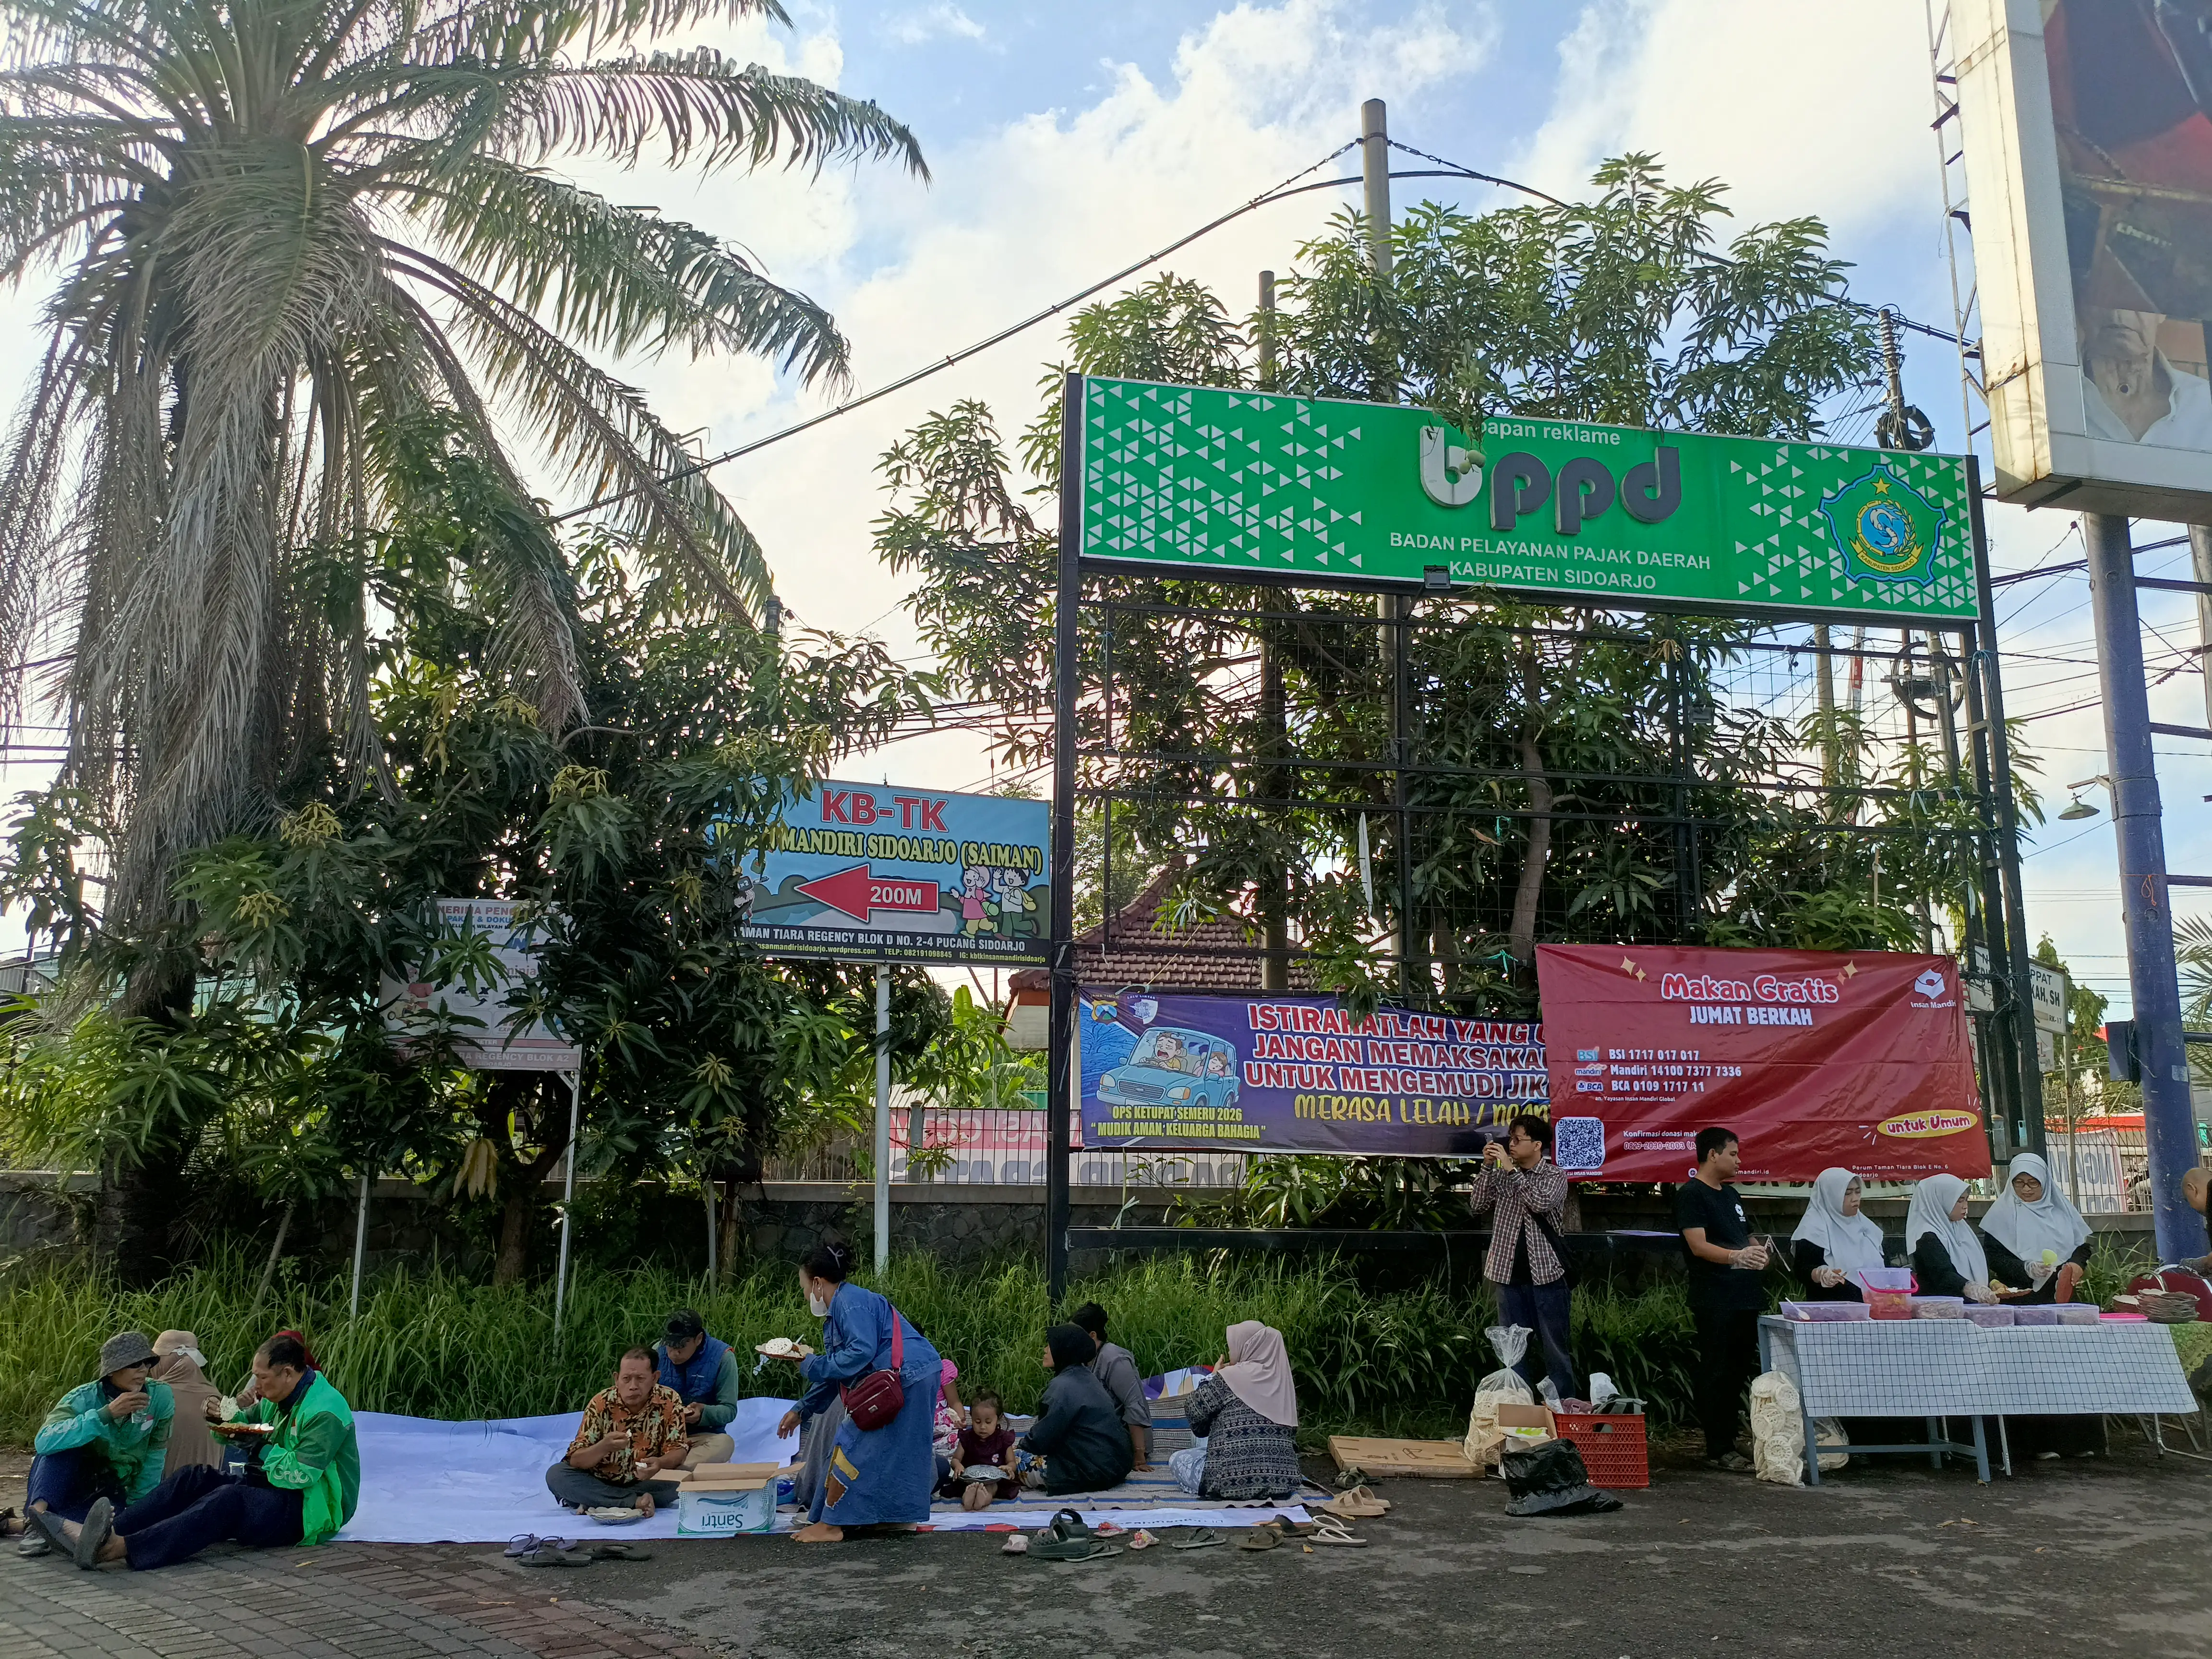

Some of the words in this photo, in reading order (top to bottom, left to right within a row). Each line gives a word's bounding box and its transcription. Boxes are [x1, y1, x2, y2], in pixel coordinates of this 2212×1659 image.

[1543, 425, 1621, 445] reklame
[1420, 425, 1681, 534] bppd
[1391, 532, 1455, 551] BADAN
[1461, 538, 1568, 559] PELAYANAN
[1574, 546, 1632, 564] PAJAK
[1637, 551, 1710, 570] DAERAH
[1860, 554, 1890, 571] KABUPATEN
[1891, 558, 1915, 571] SIDOARJO
[1449, 561, 1559, 582] KABUPATEN
[1564, 569, 1656, 589] SIDOARJO
[821, 789, 949, 833] KB-TK
[780, 827, 864, 856] MANDIRI
[867, 834, 958, 864] SIDOARJO
[961, 841, 1043, 876] (SAIMAN)
[869, 885, 923, 906] 200M
[773, 928, 805, 941] TIARA
[806, 930, 855, 943] REGENCY
[857, 932, 883, 945] BLOK
[886, 934, 894, 945] D
[896, 935, 914, 946] NO.
[915, 936, 934, 947] 2-4
[936, 937, 976, 949] PUCANG
[978, 939, 1026, 952] SIDOARJO
[884, 948, 902, 956] TELP:
[903, 949, 952, 959] 082191098845
[455, 986, 492, 995] RX
[1660, 973, 1751, 1001] Makan
[1754, 975, 1839, 1003] Gratis
[2050, 989, 2060, 1007] SH
[1247, 1003, 1447, 1041] ISTIRAHATLAH
[1450, 1019, 1529, 1045] YANG
[1690, 1006, 1742, 1024] JUMAT
[1747, 1008, 1813, 1025] BERKAH
[2049, 1014, 2062, 1024] RK-17
[475, 1052, 524, 1061] REGENCY
[527, 1054, 554, 1062] BLOK
[1252, 1033, 1363, 1064] JANGAN
[1578, 1050, 1598, 1061] BSI
[1609, 1049, 1625, 1060] BSI
[1628, 1049, 1654, 1060] 1717
[1658, 1050, 1677, 1060] 017
[1680, 1050, 1699, 1061] 017
[1243, 1061, 1337, 1091] UNTUK
[1338, 1066, 1503, 1098] MENGEMUDI
[1610, 1064, 1647, 1076] Mandiri
[1650, 1065, 1683, 1076] 14100
[1686, 1066, 1711, 1077] 7377
[1715, 1066, 1742, 1077] 7336
[1587, 1082, 1603, 1091] BCA
[1611, 1081, 1630, 1092] BCA
[1633, 1081, 1659, 1092] 0109
[1662, 1081, 1688, 1092] 1717
[1692, 1082, 1705, 1092] 11
[1112, 1106, 1132, 1119] OPS
[1134, 1106, 1175, 1120] KETUPAT
[1177, 1106, 1215, 1120] SEMERU
[1217, 1107, 1242, 1121] 2026
[1294, 1094, 1391, 1123] MERASA
[1400, 1098, 1471, 1126] LELAH
[1166, 1123, 1215, 1138] KELUARGA
[1886, 1117, 1928, 1134] untuk
[1929, 1114, 1972, 1129] Umum
[1686, 1141, 1697, 1151] (A
[701, 1514, 744, 1529] Santri
